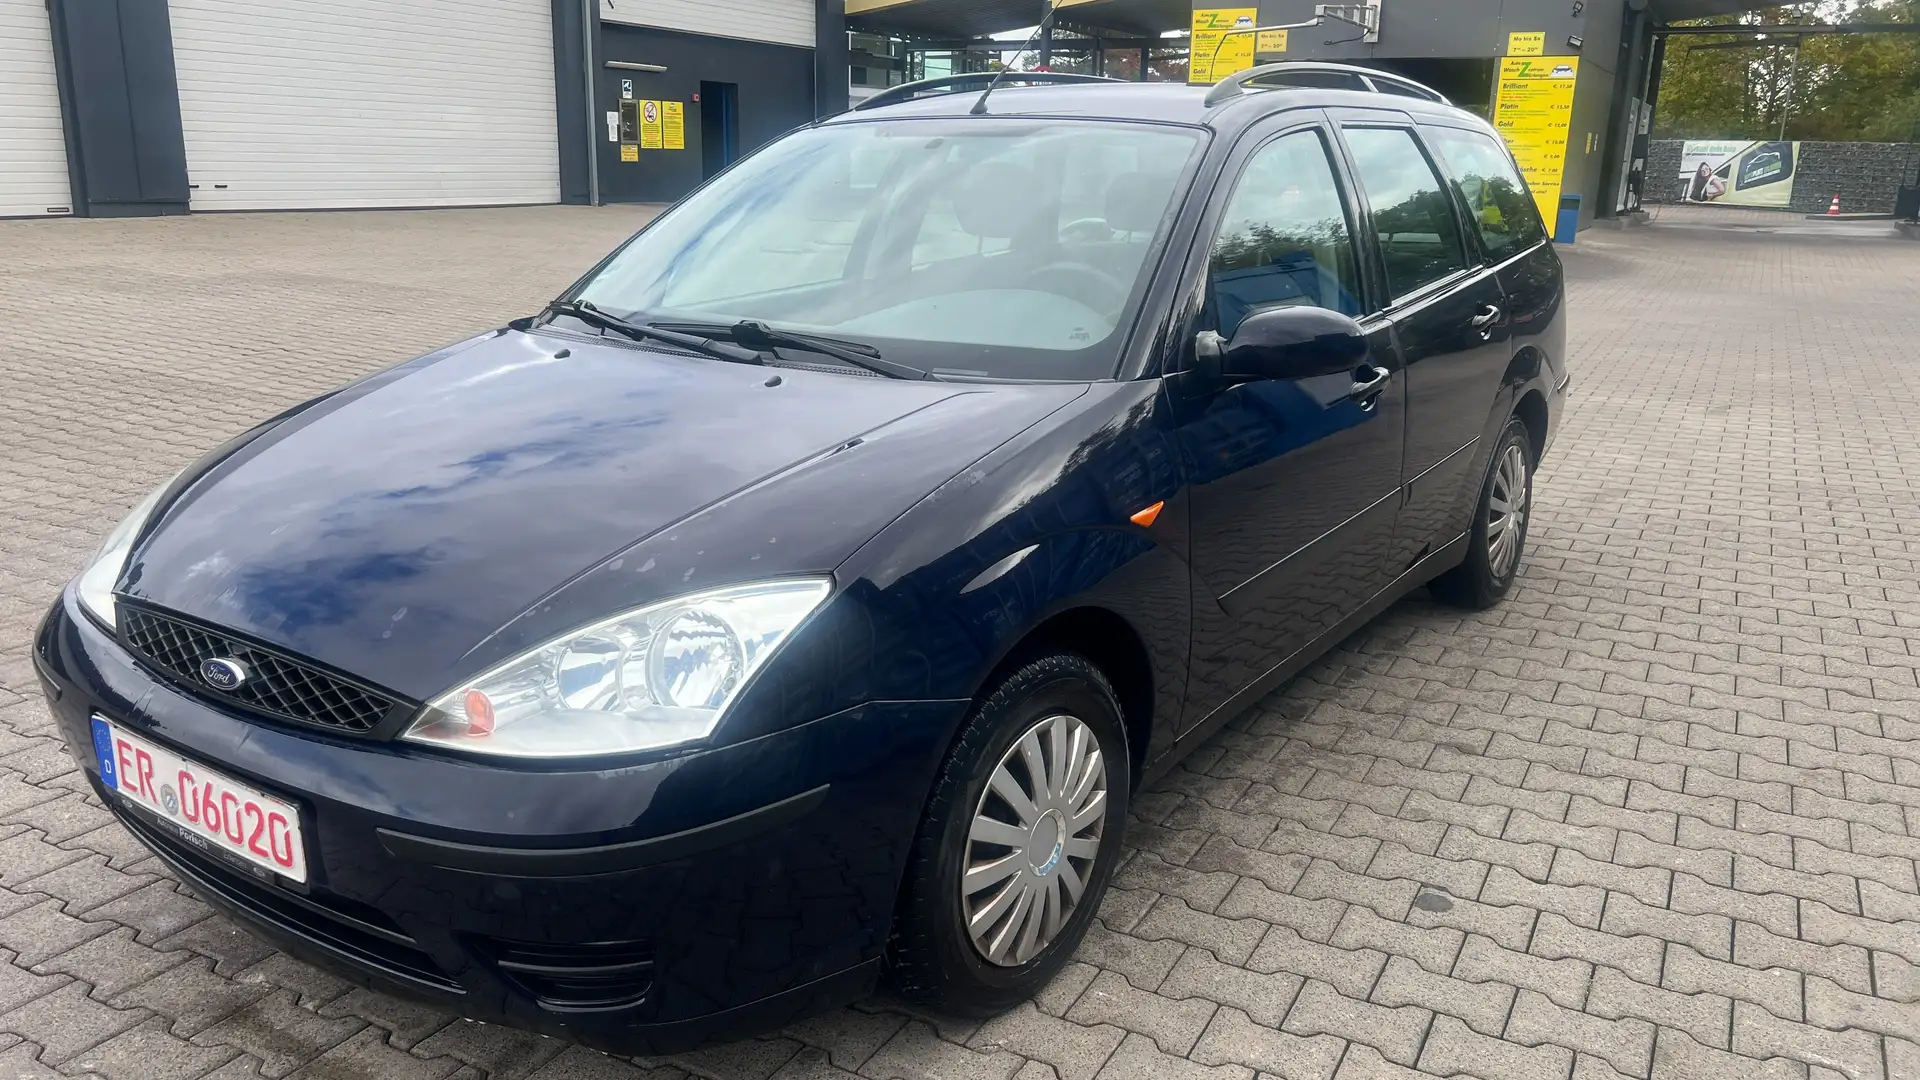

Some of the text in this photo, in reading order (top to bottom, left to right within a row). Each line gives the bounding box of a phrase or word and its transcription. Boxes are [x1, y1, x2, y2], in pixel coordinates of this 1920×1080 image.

[208, 664, 230, 684] Ford
[104, 759, 112, 774] D
[116, 738, 294, 869] ER 06020
